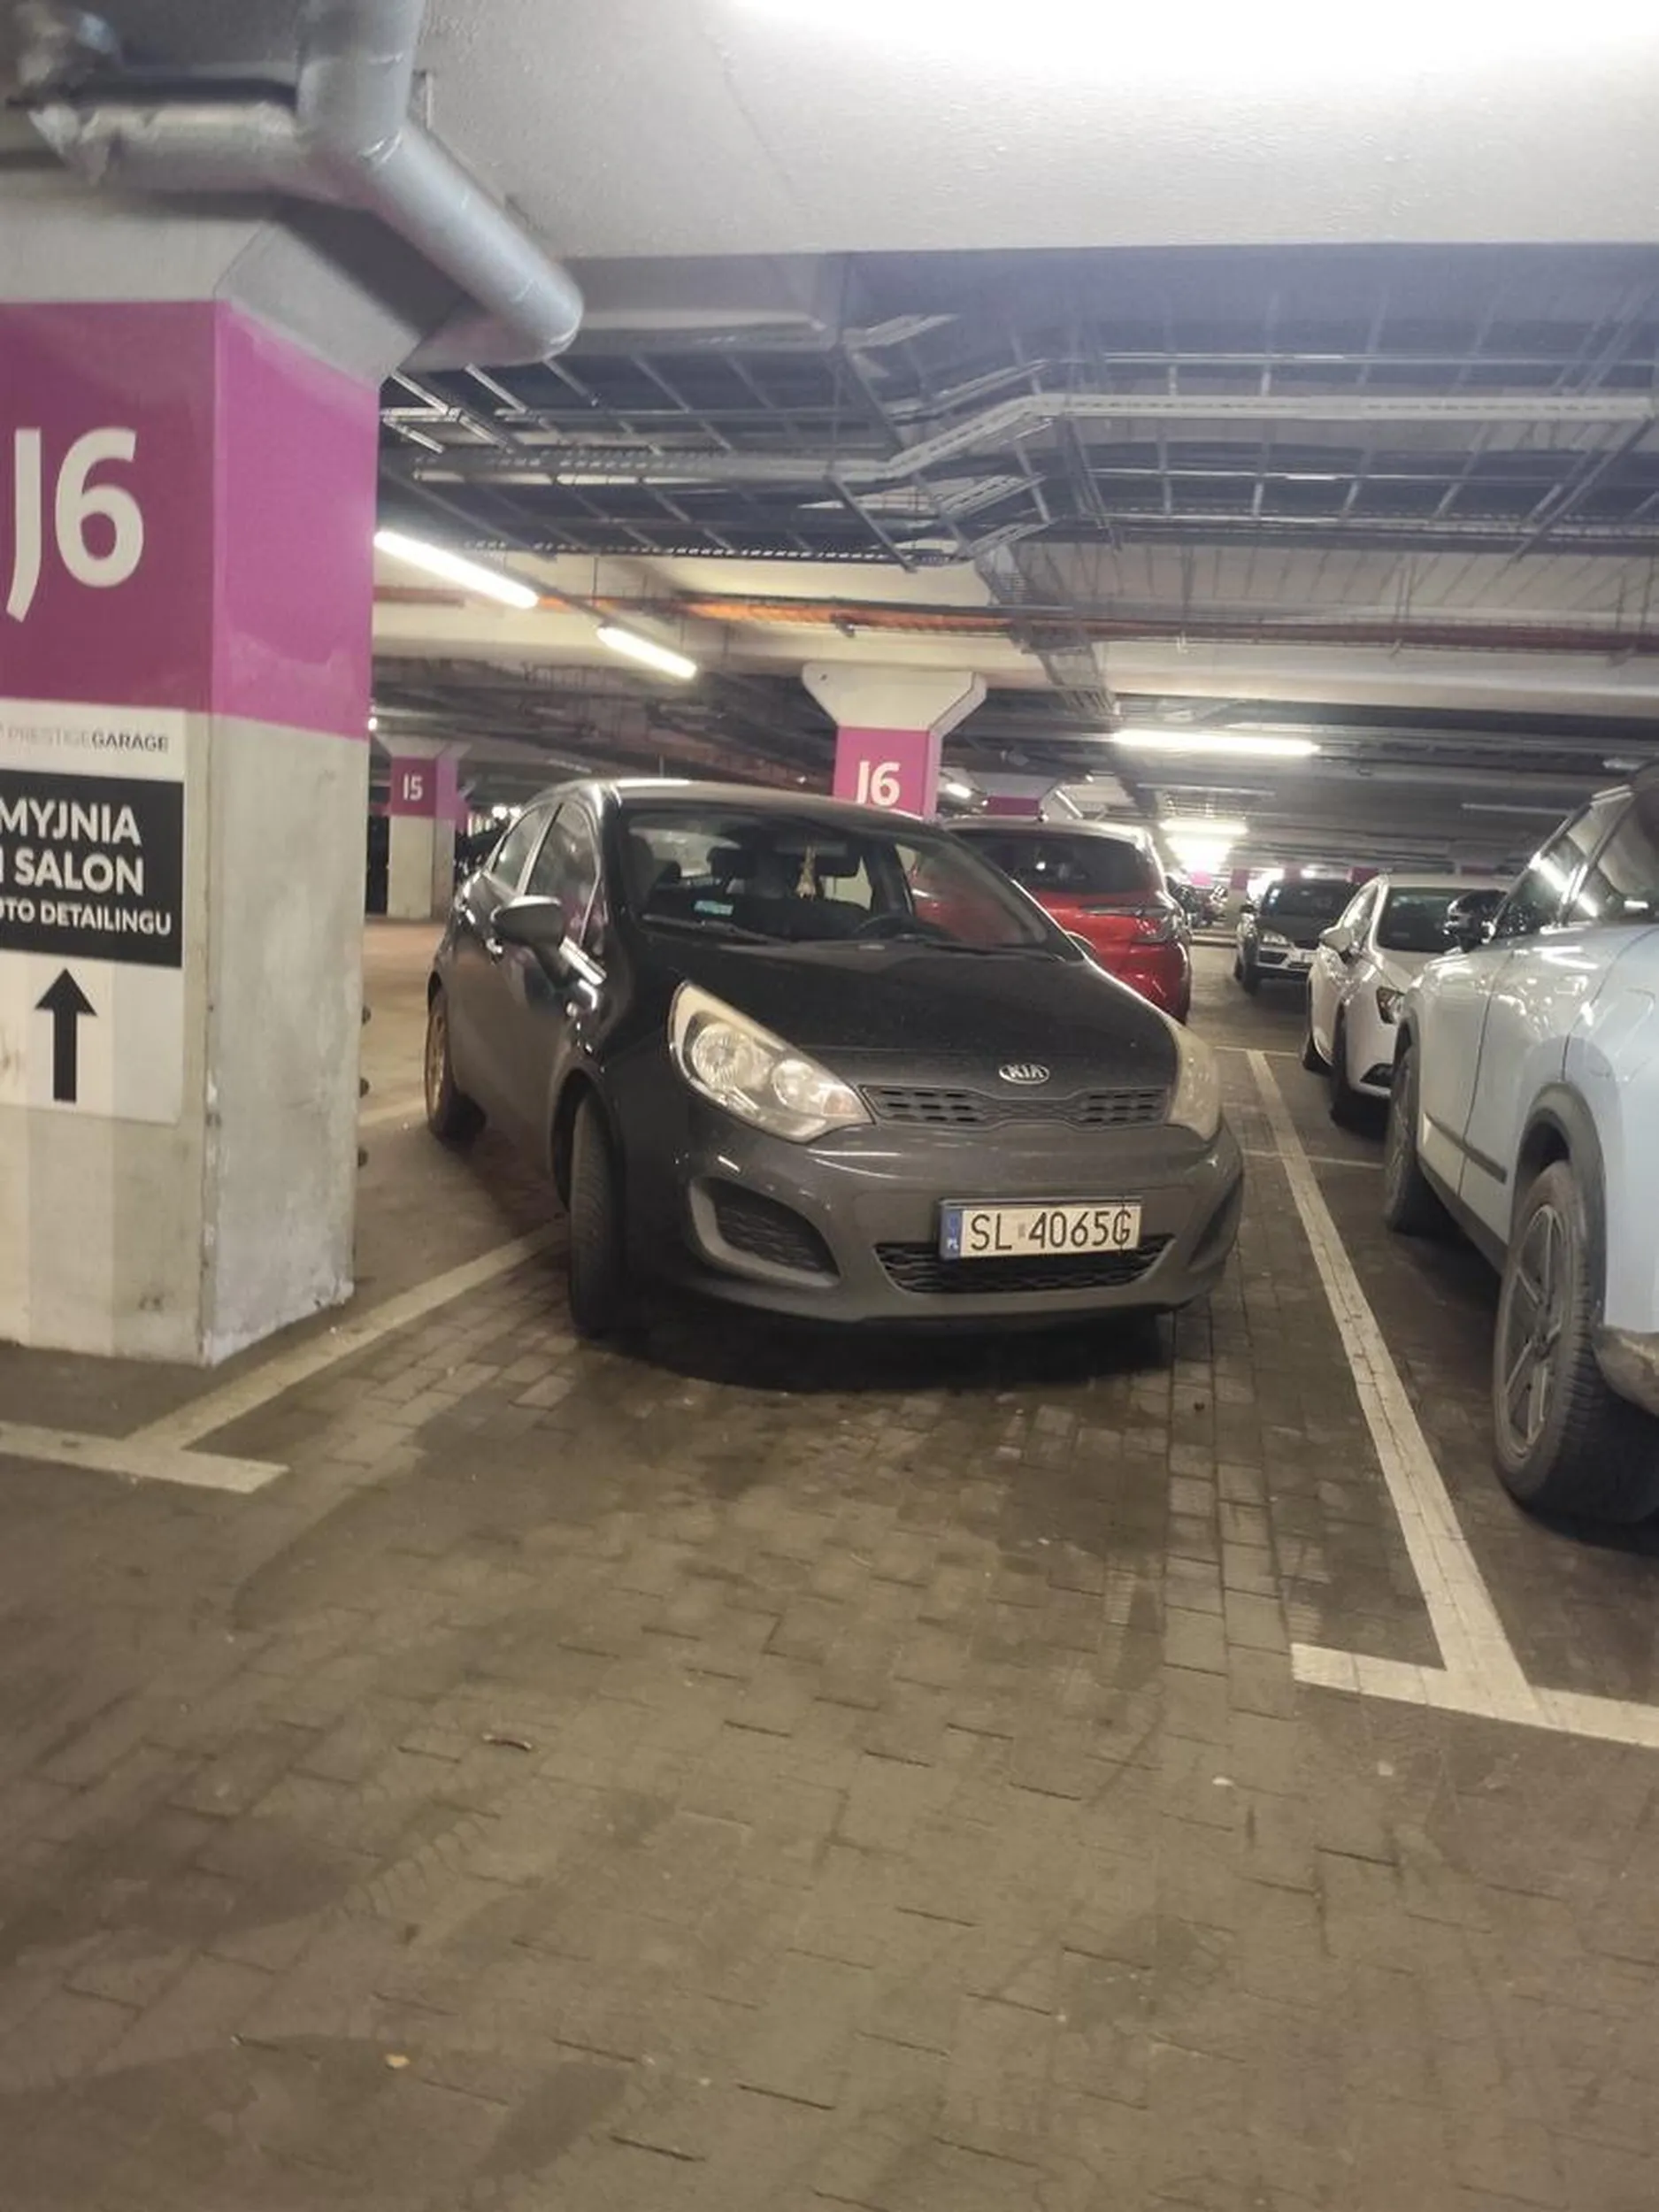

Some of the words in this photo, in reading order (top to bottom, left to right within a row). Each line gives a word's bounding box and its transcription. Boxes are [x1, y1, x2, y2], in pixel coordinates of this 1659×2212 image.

[6, 426, 144, 622] J6
[0, 797, 142, 847] MYJNIA
[14, 846, 144, 896] SALON
[0, 896, 35, 923] TO
[41, 899, 172, 935] DETAILINGU
[1005, 1064, 1046, 1079] KIA
[971, 1213, 1012, 1250] SL
[1028, 1209, 1132, 1248] 4065G
